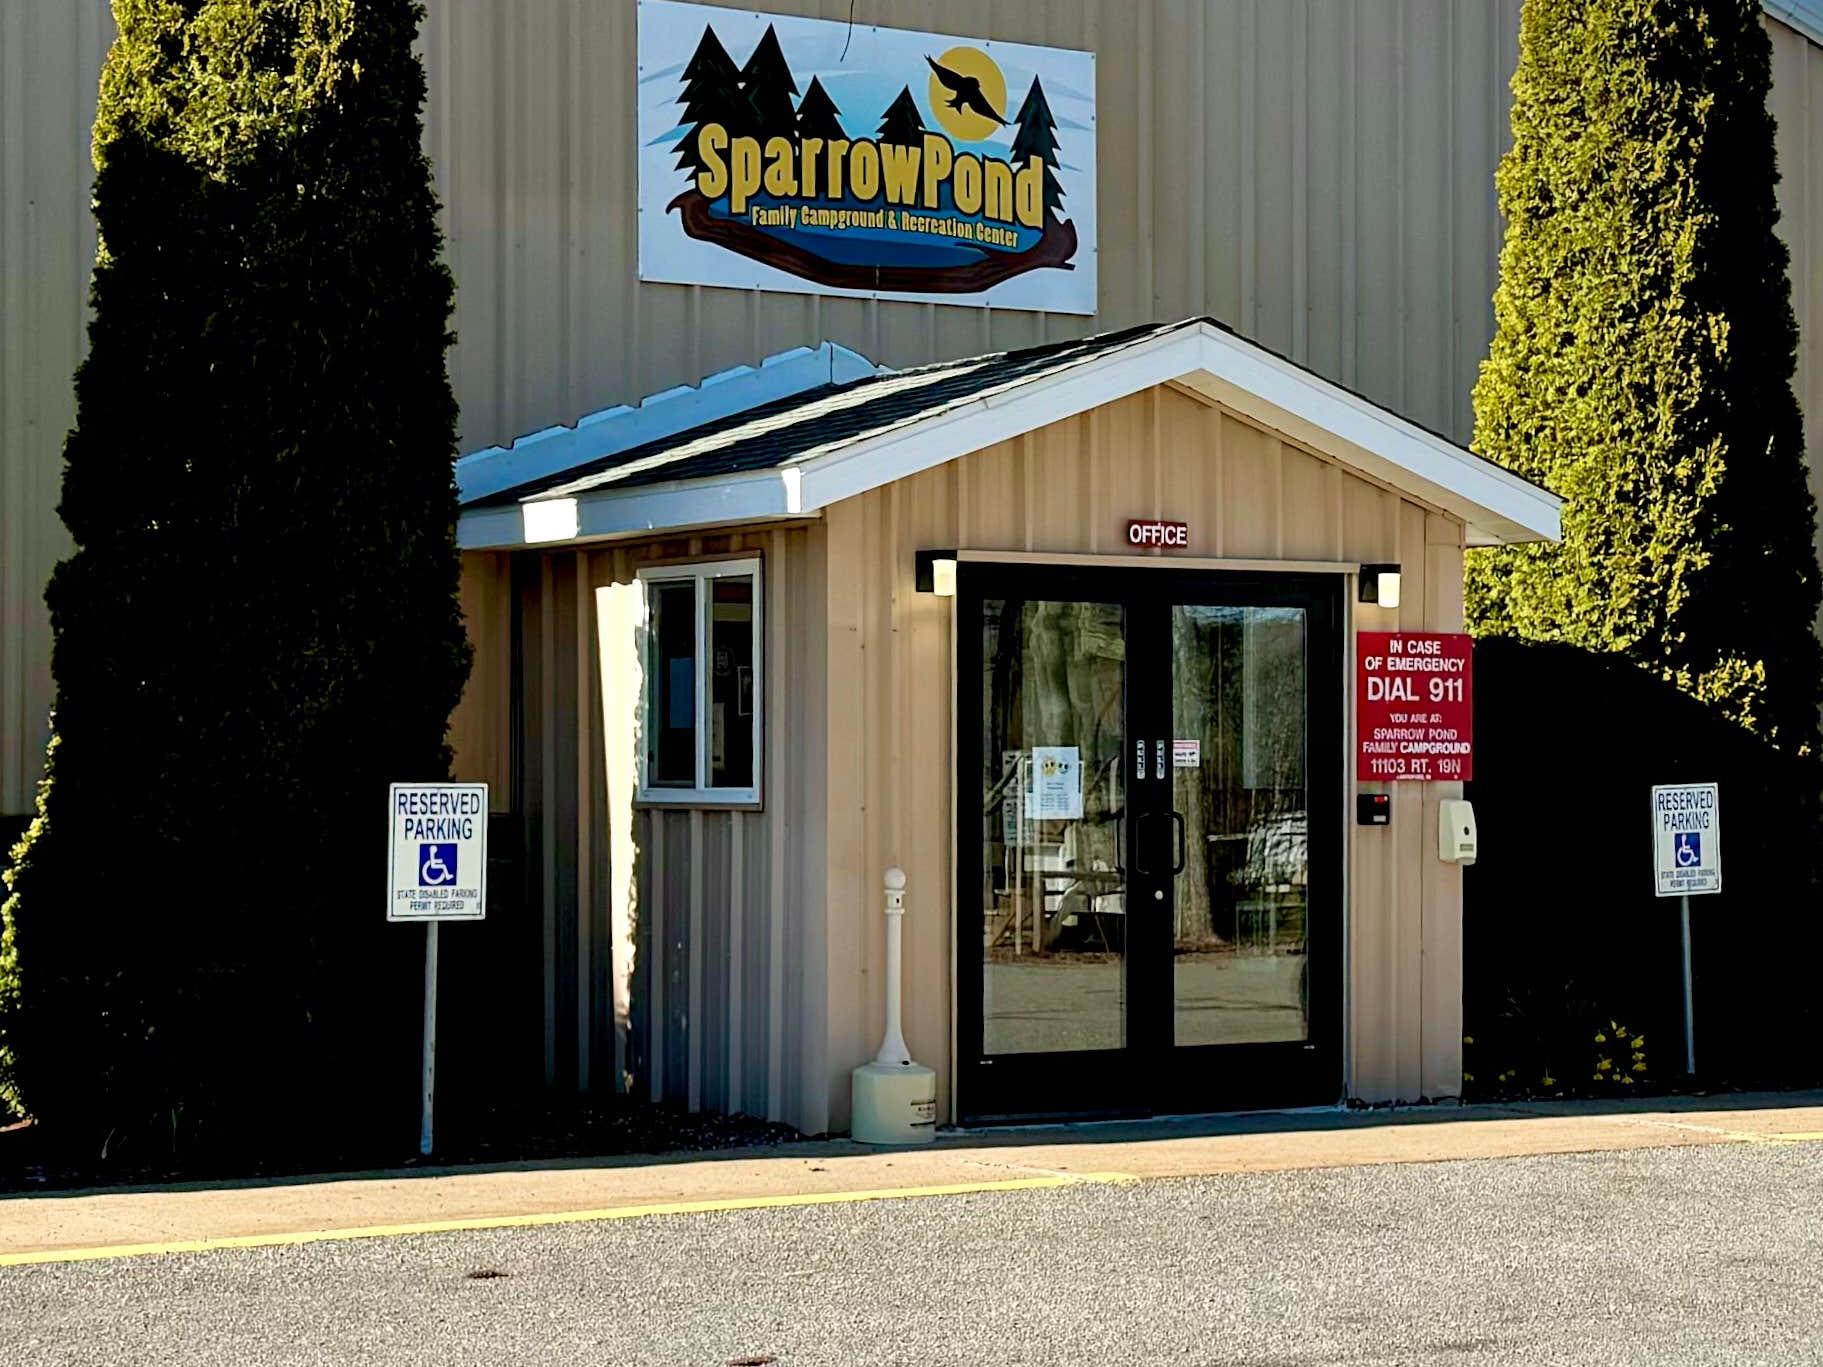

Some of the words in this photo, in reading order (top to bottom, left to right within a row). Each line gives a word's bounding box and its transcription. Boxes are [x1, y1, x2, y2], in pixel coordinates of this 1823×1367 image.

[698, 123, 1043, 229] SparrowPond
[752, 205, 796, 228] Family
[801, 207, 884, 230] Campground
[888, 210, 898, 229] &
[901, 211, 972, 240] Recreation
[976, 222, 1018, 248] Center
[1130, 524, 1187, 544] OFFICE
[1389, 640, 1402, 654] IN
[1407, 641, 1441, 654] CASE
[1365, 656, 1383, 670] OF
[1387, 657, 1465, 672] EMERGENCY
[1367, 677, 1420, 701] DIAL
[1429, 678, 1463, 702] 911
[1389, 713, 1408, 723] YOU
[1410, 714, 1427, 723] ARE
[1374, 728, 1425, 740] SPARROW
[1429, 729, 1457, 740] POND
[1362, 741, 1398, 753] FAMILY
[1400, 742, 1471, 754] CAMPGROUND
[1371, 758, 1405, 773] 11103
[1411, 759, 1431, 773] RT.
[1437, 759, 1461, 773] 19N
[398, 793, 480, 815] RESERVED
[1658, 791, 1713, 811] RESERVED
[405, 818, 473, 840] PARKING
[1664, 812, 1709, 831] PARKING
